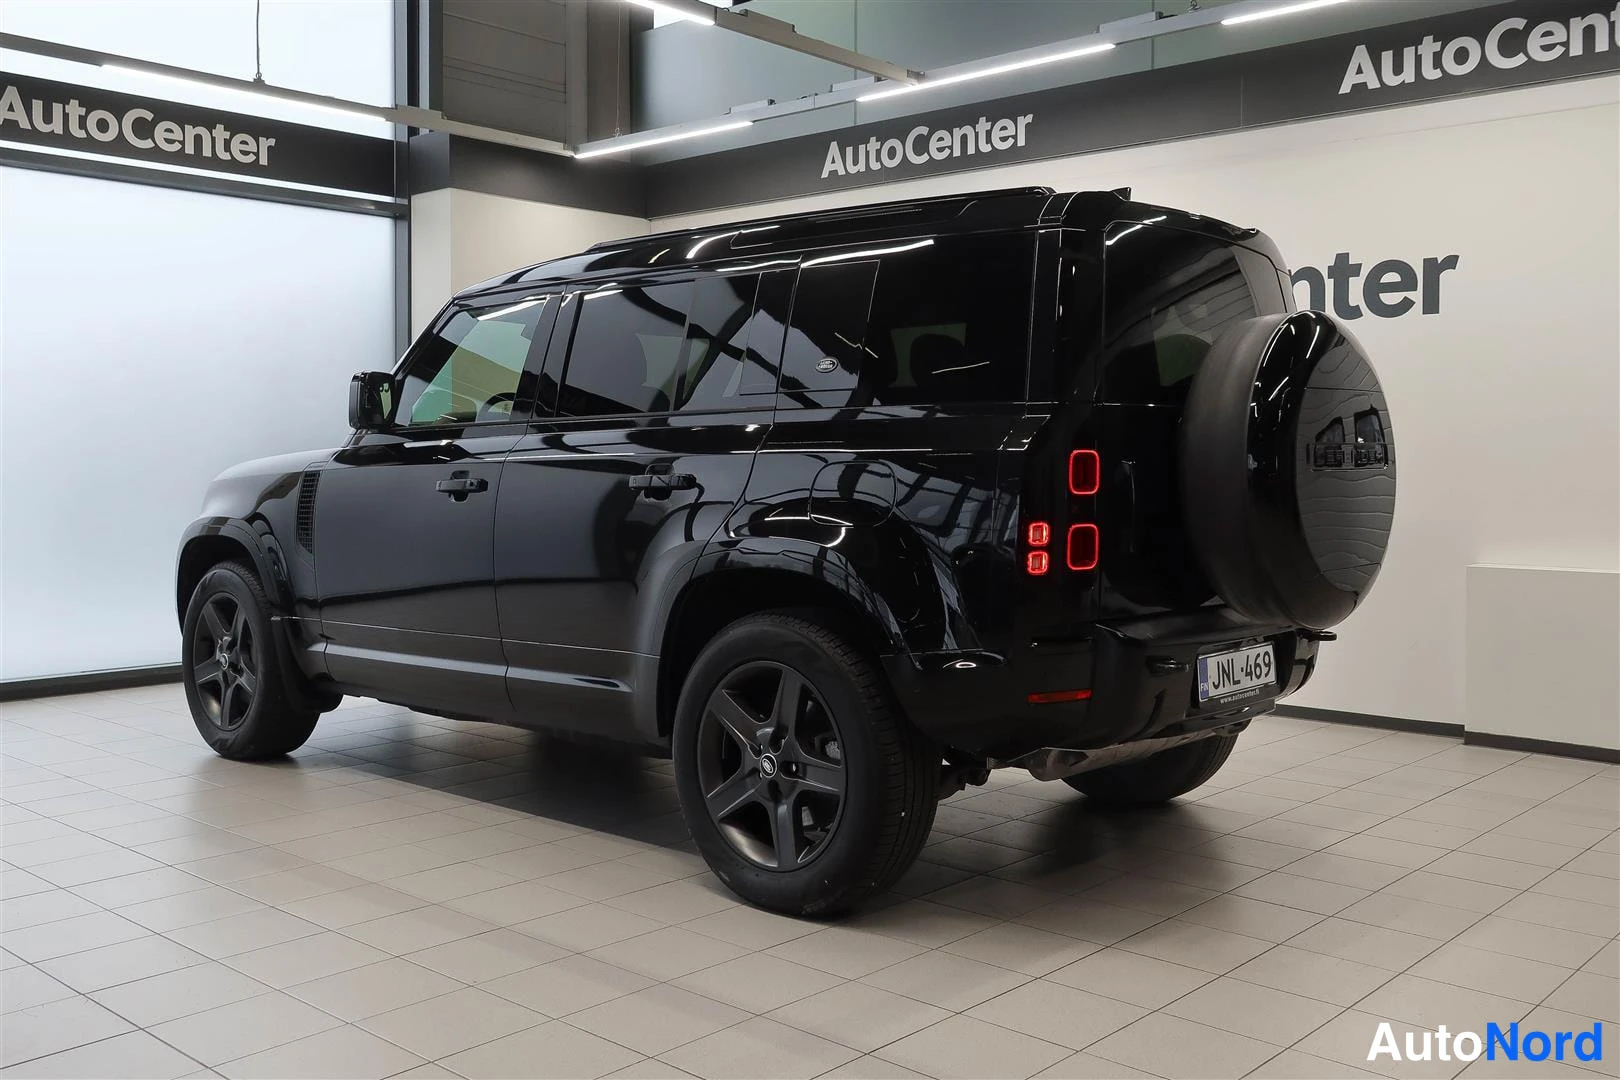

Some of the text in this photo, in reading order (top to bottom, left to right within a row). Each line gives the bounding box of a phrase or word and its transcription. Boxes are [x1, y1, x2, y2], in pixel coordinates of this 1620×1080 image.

[0, 85, 276, 167] AutoCenter
[821, 113, 1034, 179] AutoCenter
[1212, 650, 1272, 690] JNL-469
